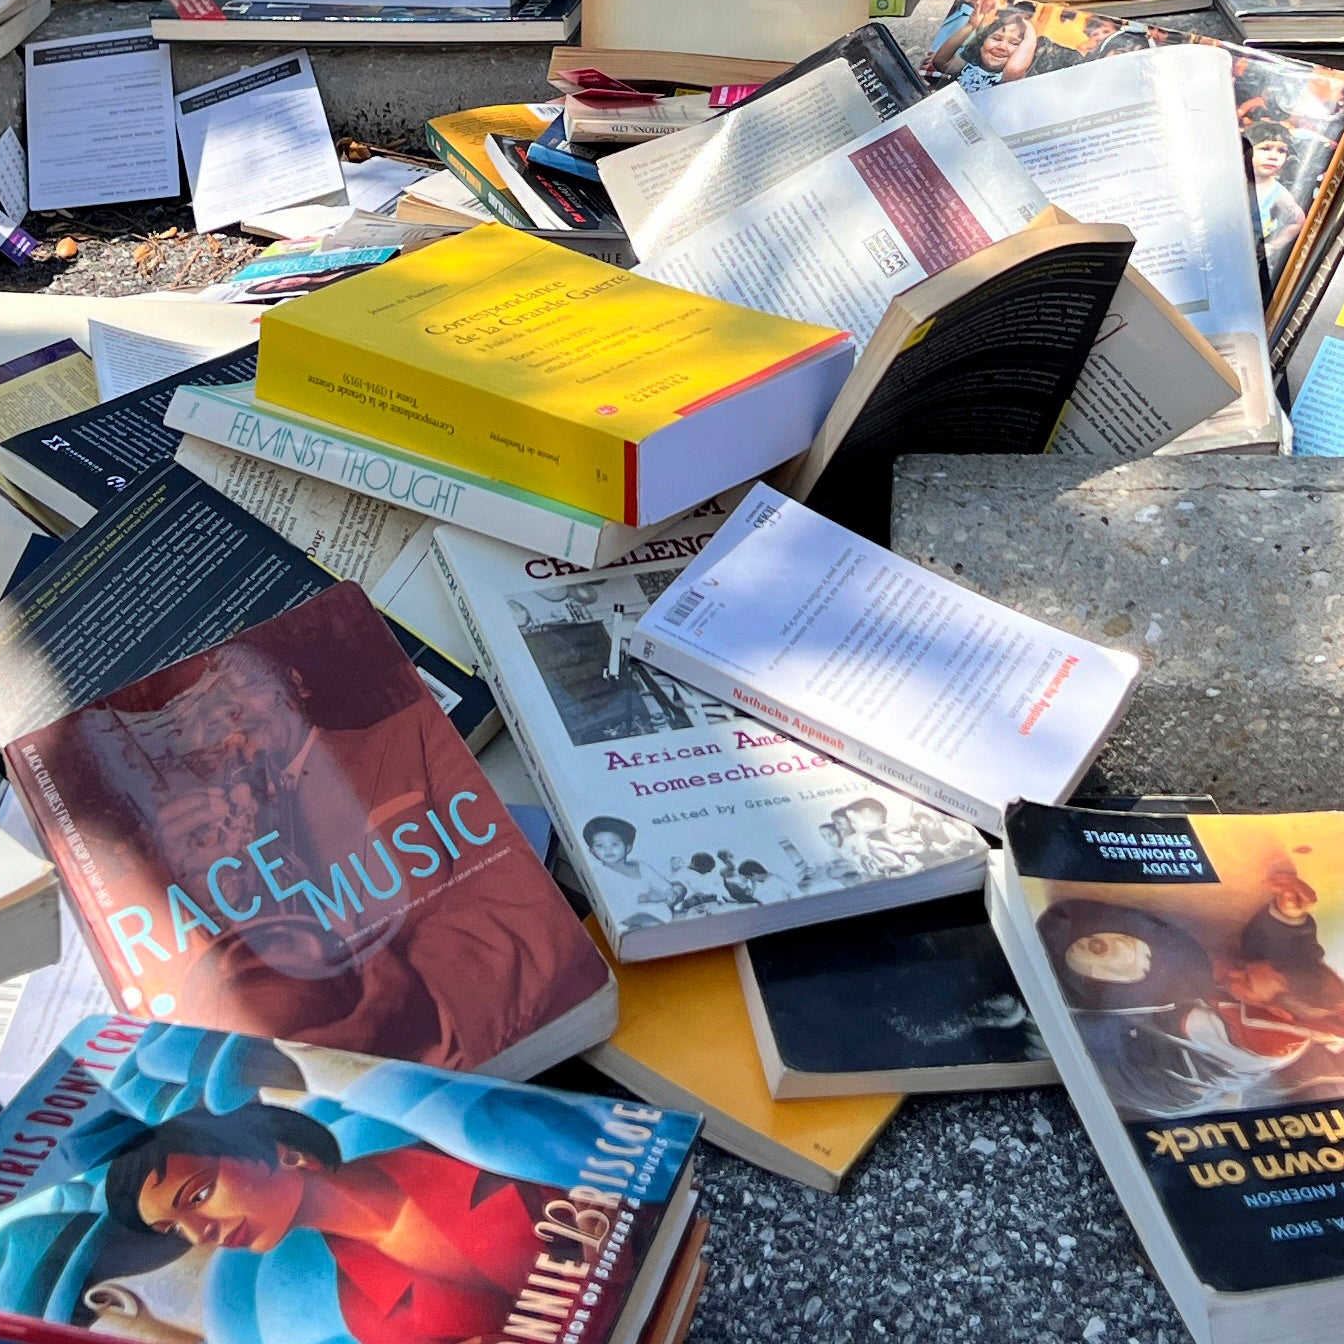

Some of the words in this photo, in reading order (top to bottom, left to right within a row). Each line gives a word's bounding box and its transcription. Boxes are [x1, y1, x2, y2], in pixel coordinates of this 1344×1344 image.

[610, 123, 632, 135] LTD.
[633, 123, 678, 137] EDITIONS,
[423, 280, 567, 337] Correspondance
[454, 328, 475, 347] de
[483, 320, 501, 337] la
[498, 293, 570, 329] Grande
[564, 272, 632, 304] Guerre
[227, 412, 334, 476] FEMINIST
[338, 444, 466, 519] THOUGHT
[606, 741, 722, 772] African
[731, 686, 791, 726] Nathacha
[791, 711, 845, 752] Appanah
[875, 757, 934, 797] attendant
[933, 788, 980, 820] demain
[651, 806, 710, 826] edited
[716, 802, 737, 820] by
[743, 793, 793, 811] Grace
[54, 807, 78, 836] FROM
[66, 831, 92, 863] BEBOP
[1082, 829, 1139, 847] PEOPLE
[1140, 832, 1193, 848] STREET
[301, 790, 497, 932] MUSIC
[1099, 845, 1177, 861] HOMELESS
[1142, 861, 1191, 877] STUDY
[1177, 848, 1199, 862] OF
[107, 829, 306, 975] RACE
[25, 1056, 117, 1129] DON'T
[85, 1014, 153, 1056] CRY
[1145, 1121, 1252, 1164] Luck
[533, 1102, 664, 1253] BRISCOE
[632, 1136, 669, 1196] LOVERS
[1188, 1159, 1248, 1190] on
[625, 1195, 641, 1211] &
[1242, 1182, 1337, 1210] ANDERSON
[594, 1209, 635, 1282] SISTERS
[1269, 1224, 1325, 1242] SNOW
[581, 1281, 603, 1307] OF
